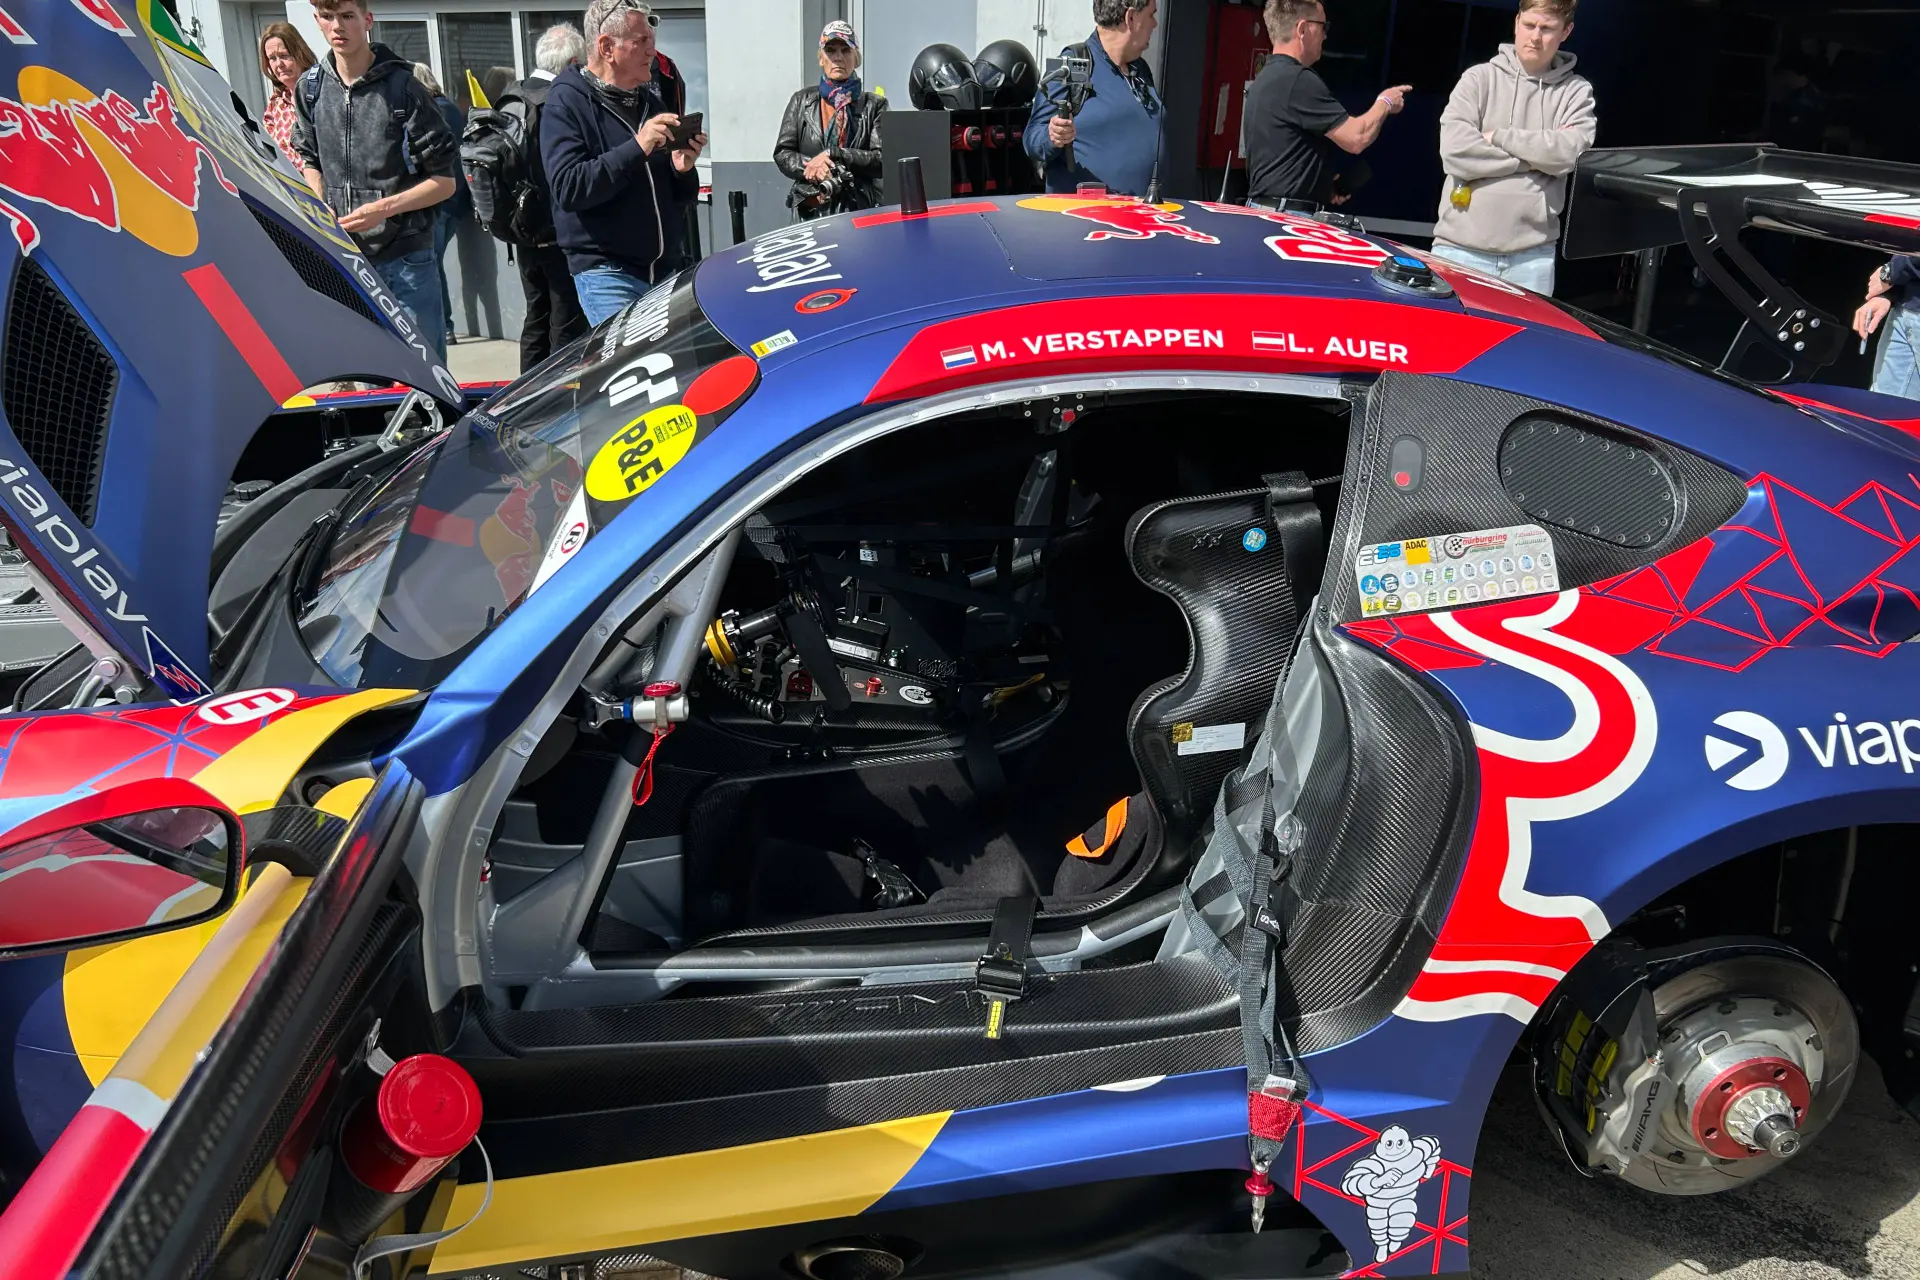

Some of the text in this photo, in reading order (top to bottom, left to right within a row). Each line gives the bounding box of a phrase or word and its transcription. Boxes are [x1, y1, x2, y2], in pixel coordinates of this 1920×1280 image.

[341, 252, 427, 362] viaplay
[980, 328, 1225, 362] M. VERSTAPPEN
[1287, 333, 1409, 365] L. AUER
[611, 418, 665, 494] P&E
[1404, 538, 1428, 551] ADAC
